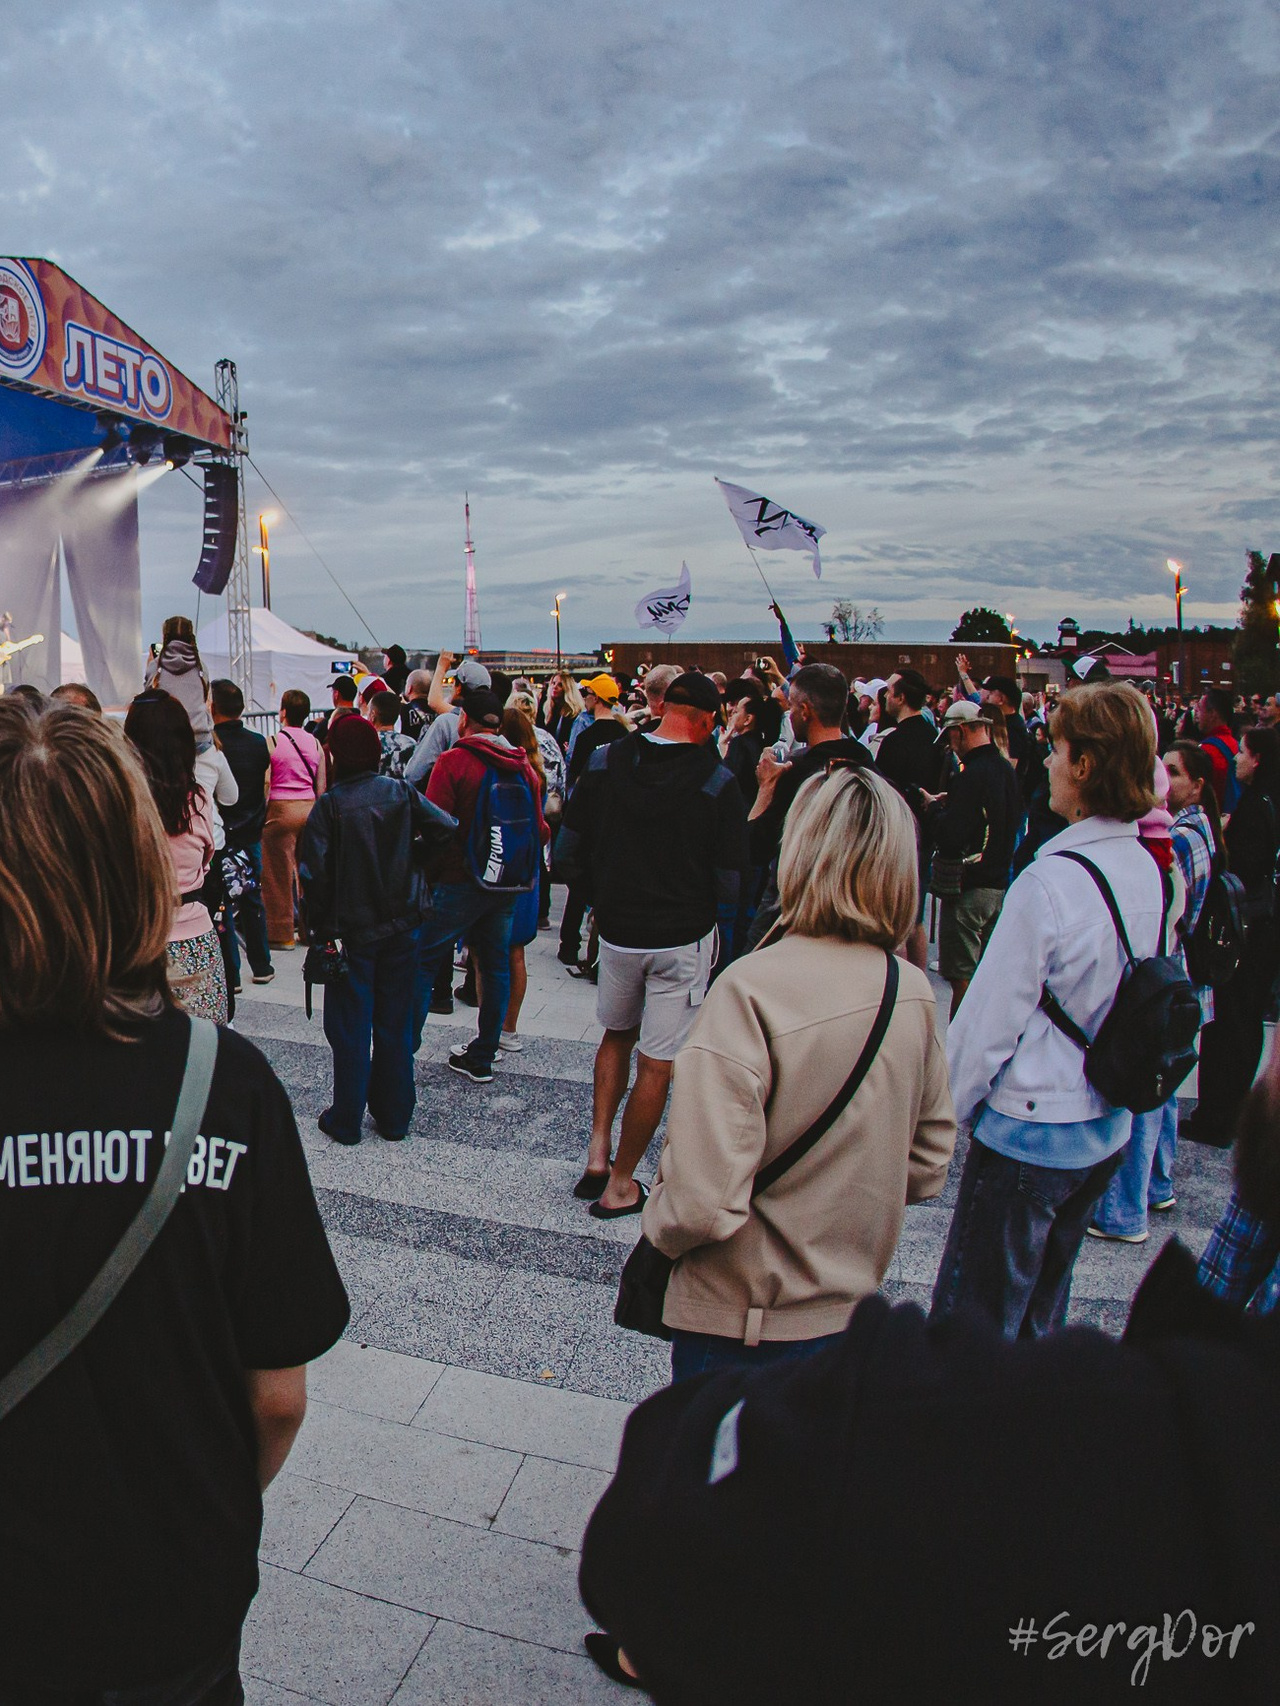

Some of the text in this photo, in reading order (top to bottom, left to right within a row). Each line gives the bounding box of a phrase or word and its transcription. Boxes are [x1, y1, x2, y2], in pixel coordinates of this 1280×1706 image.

[63, 321, 173, 419] ЛЕТО
[489, 825, 504, 863] PUMA
[164, 1130, 248, 1194] ВЕТ
